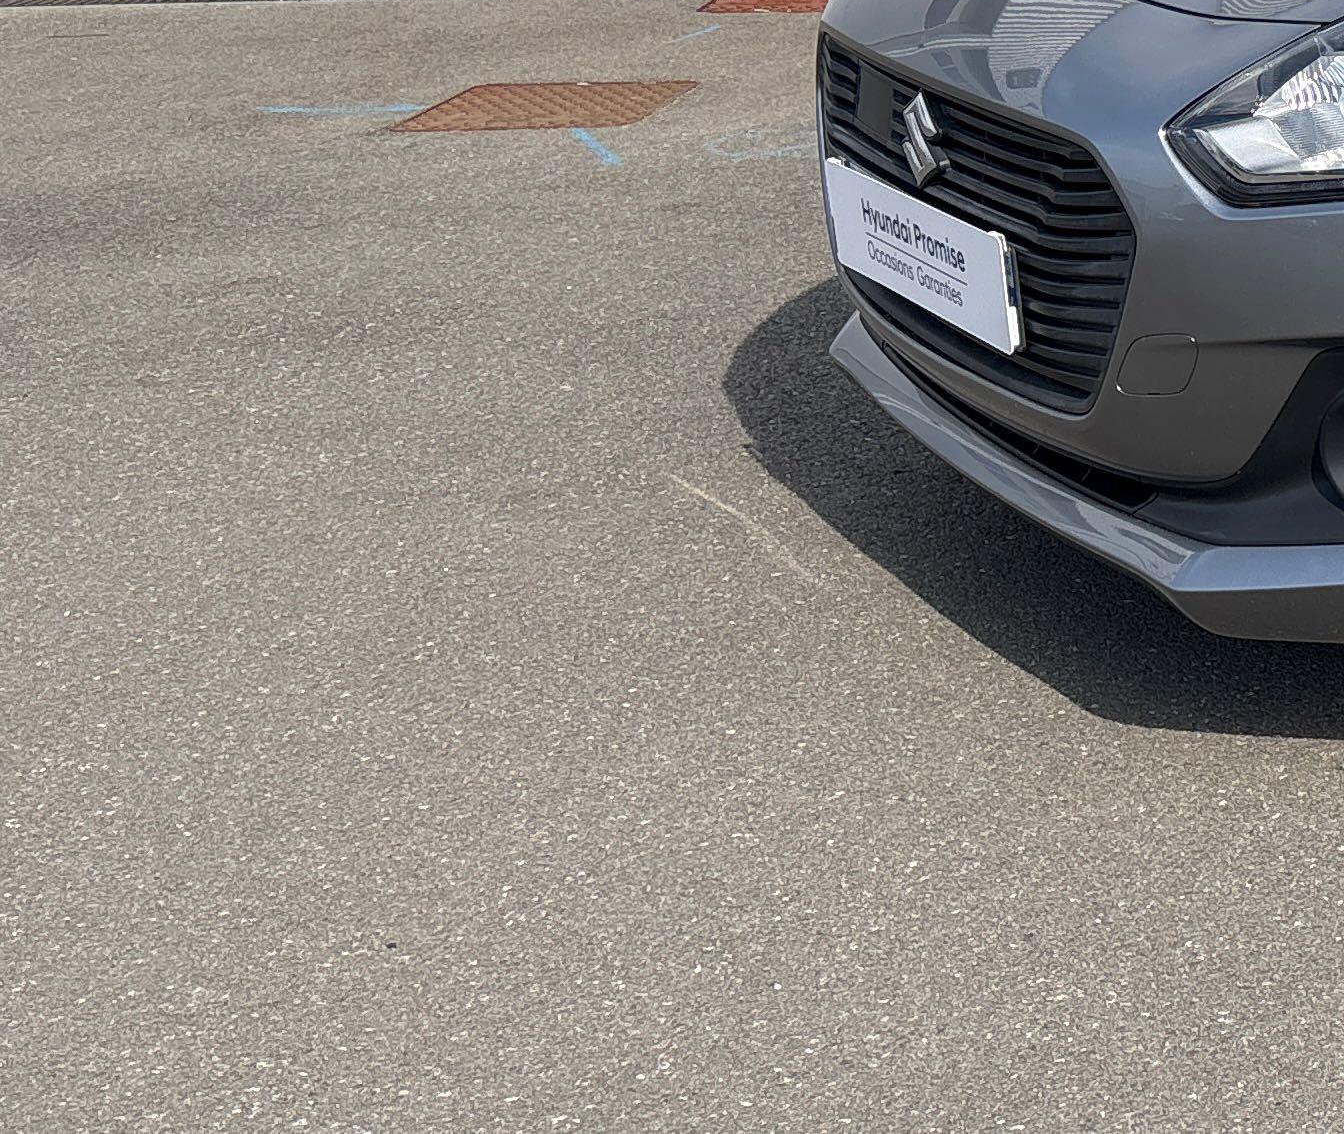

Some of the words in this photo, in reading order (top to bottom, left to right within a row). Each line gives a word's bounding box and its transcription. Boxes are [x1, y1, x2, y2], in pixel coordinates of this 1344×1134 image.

[861, 197, 913, 246] Hyundai
[913, 223, 966, 273] Promise
[867, 240, 915, 282] Occasions
[917, 265, 963, 307] Garanties
